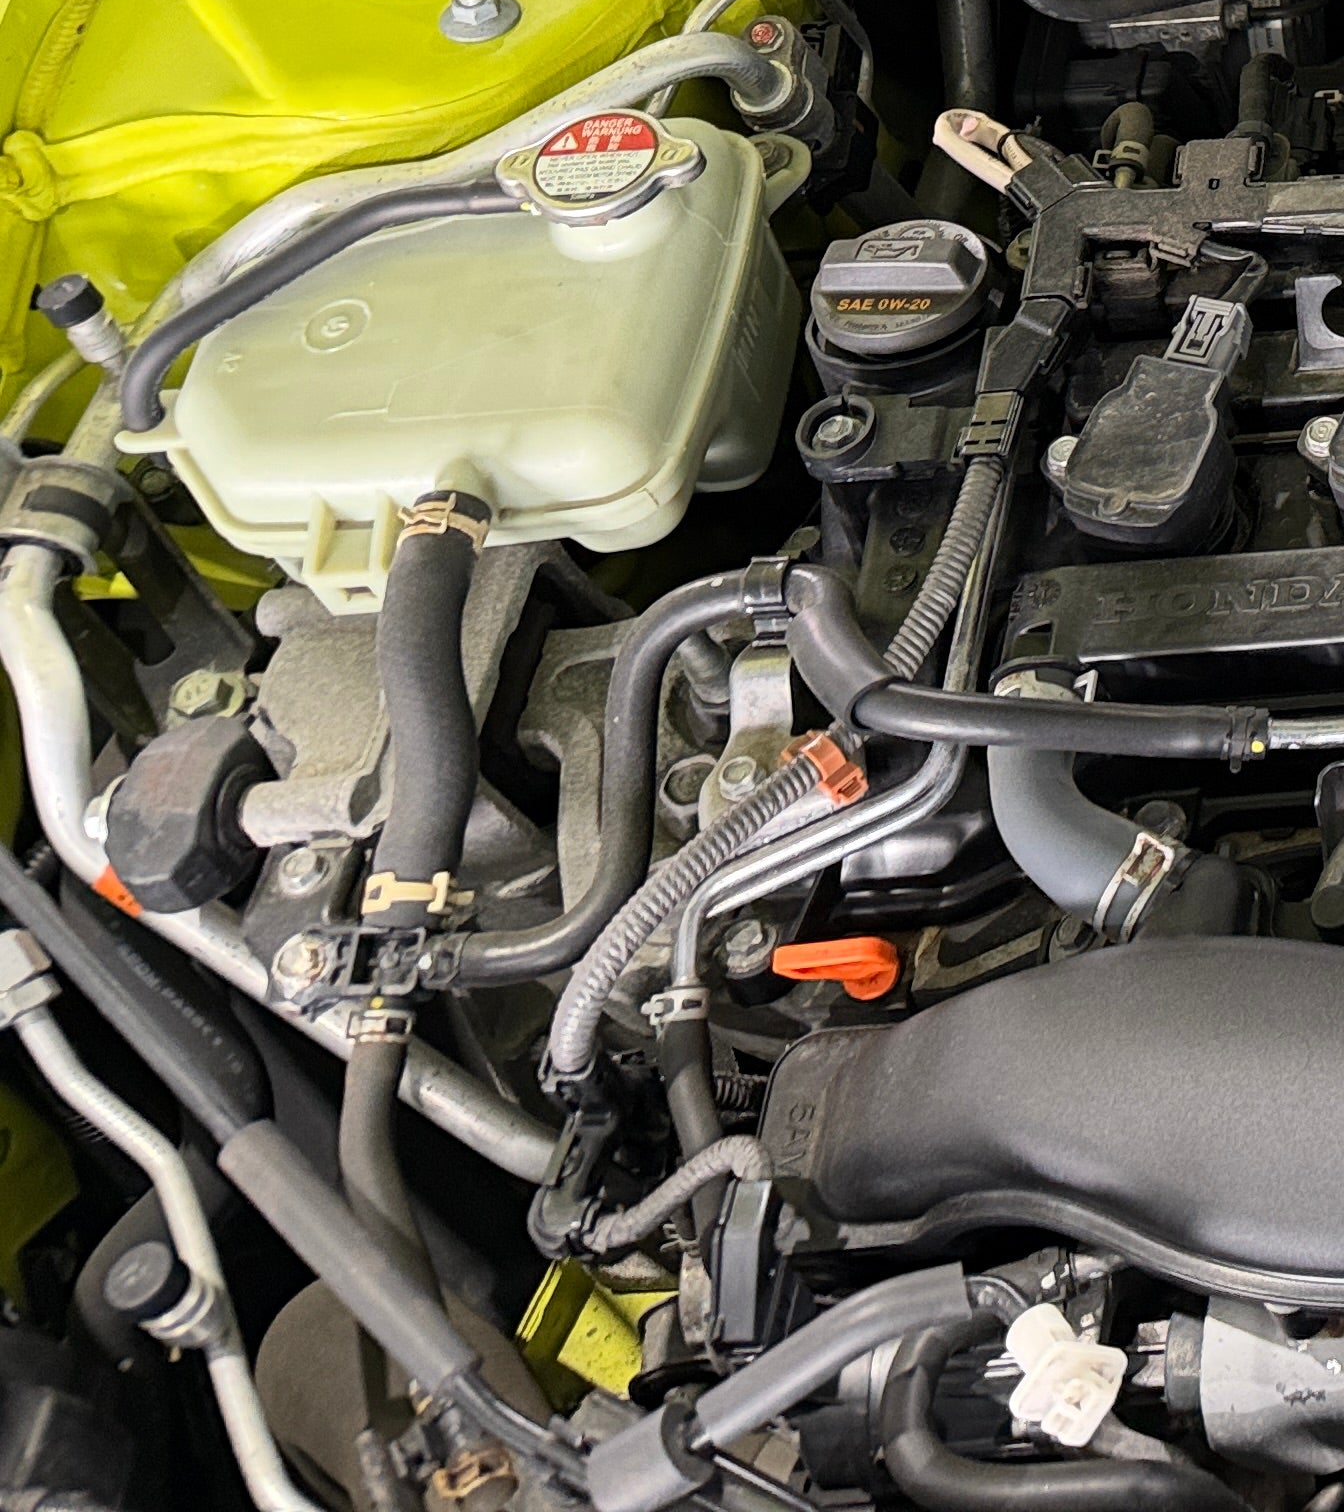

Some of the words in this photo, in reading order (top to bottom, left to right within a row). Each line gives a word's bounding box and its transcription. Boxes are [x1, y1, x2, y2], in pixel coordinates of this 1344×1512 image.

[583, 118, 634, 130] DANGER
[836, 298, 873, 311] SAE
[878, 298, 931, 310] 0W-20
